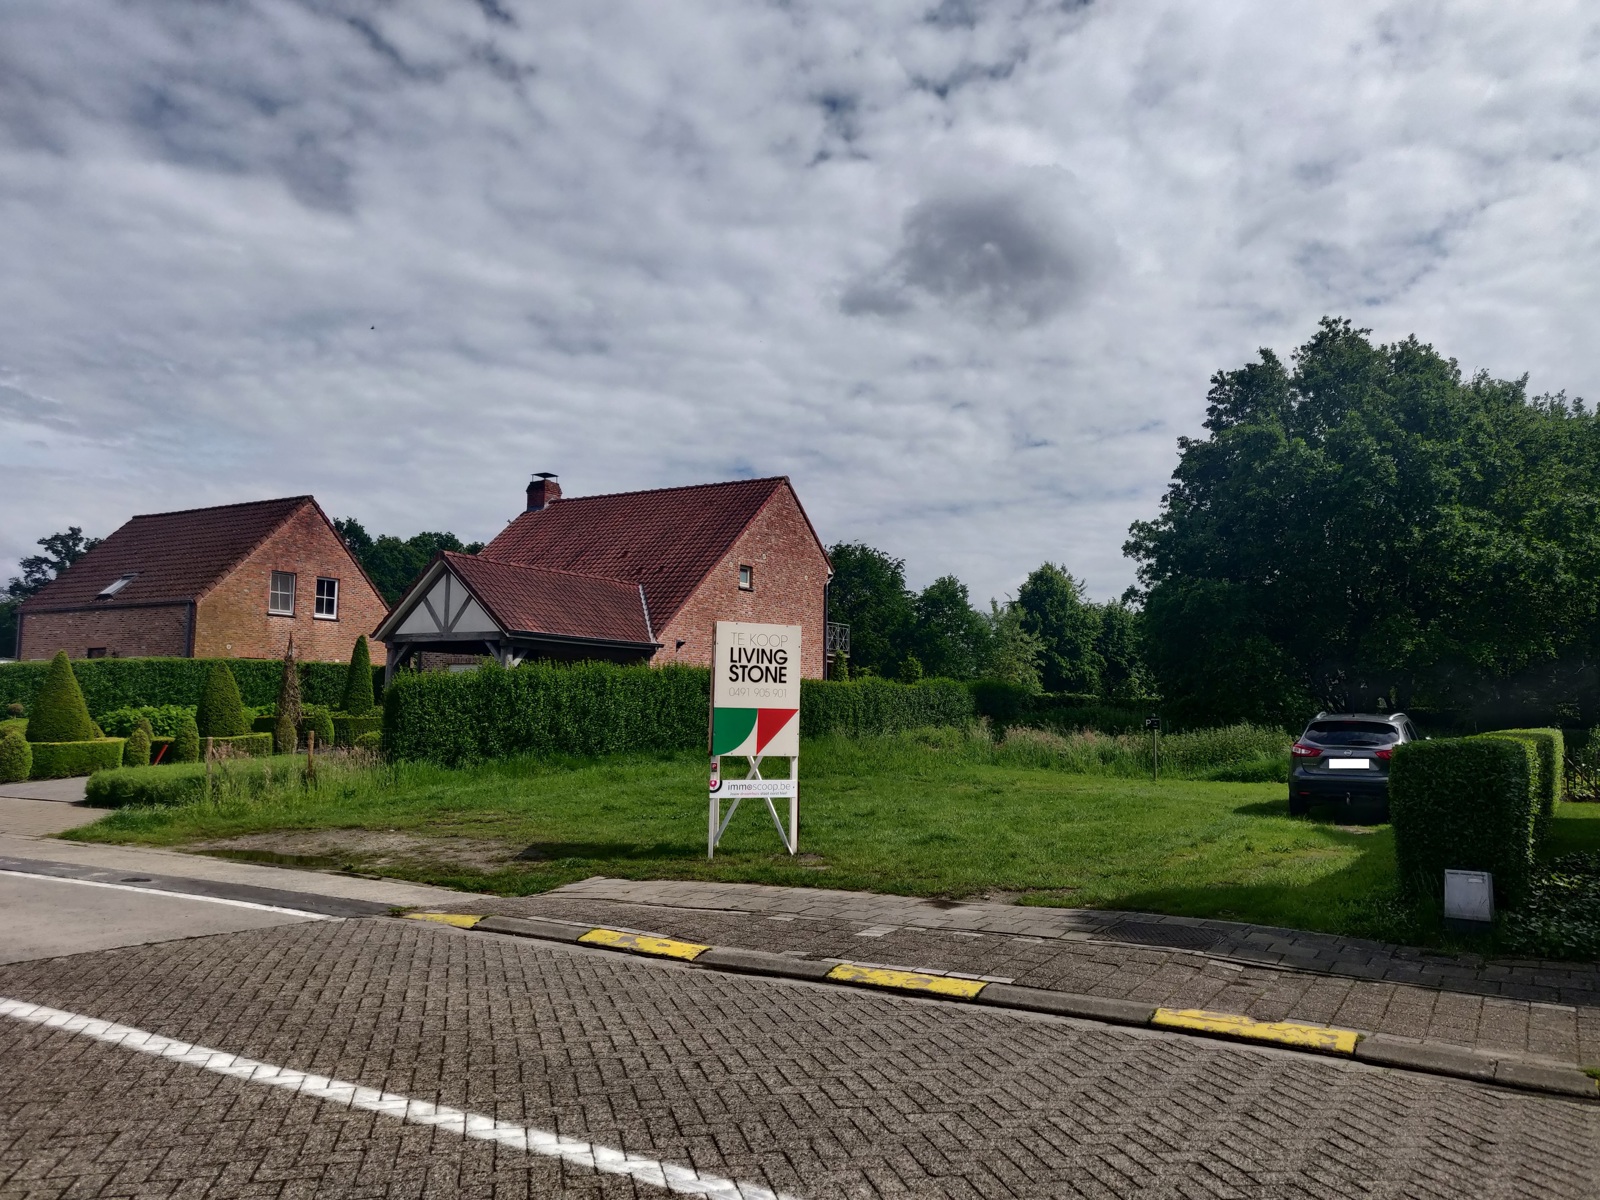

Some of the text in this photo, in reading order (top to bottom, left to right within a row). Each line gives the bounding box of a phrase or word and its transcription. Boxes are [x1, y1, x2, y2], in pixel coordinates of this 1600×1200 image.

[730, 632, 789, 648] TE KOOP
[730, 647, 788, 665] LIVING
[728, 664, 788, 684] STONE
[728, 687, 787, 698] 0491 905 901
[727, 781, 791, 792] immoscoop.be
